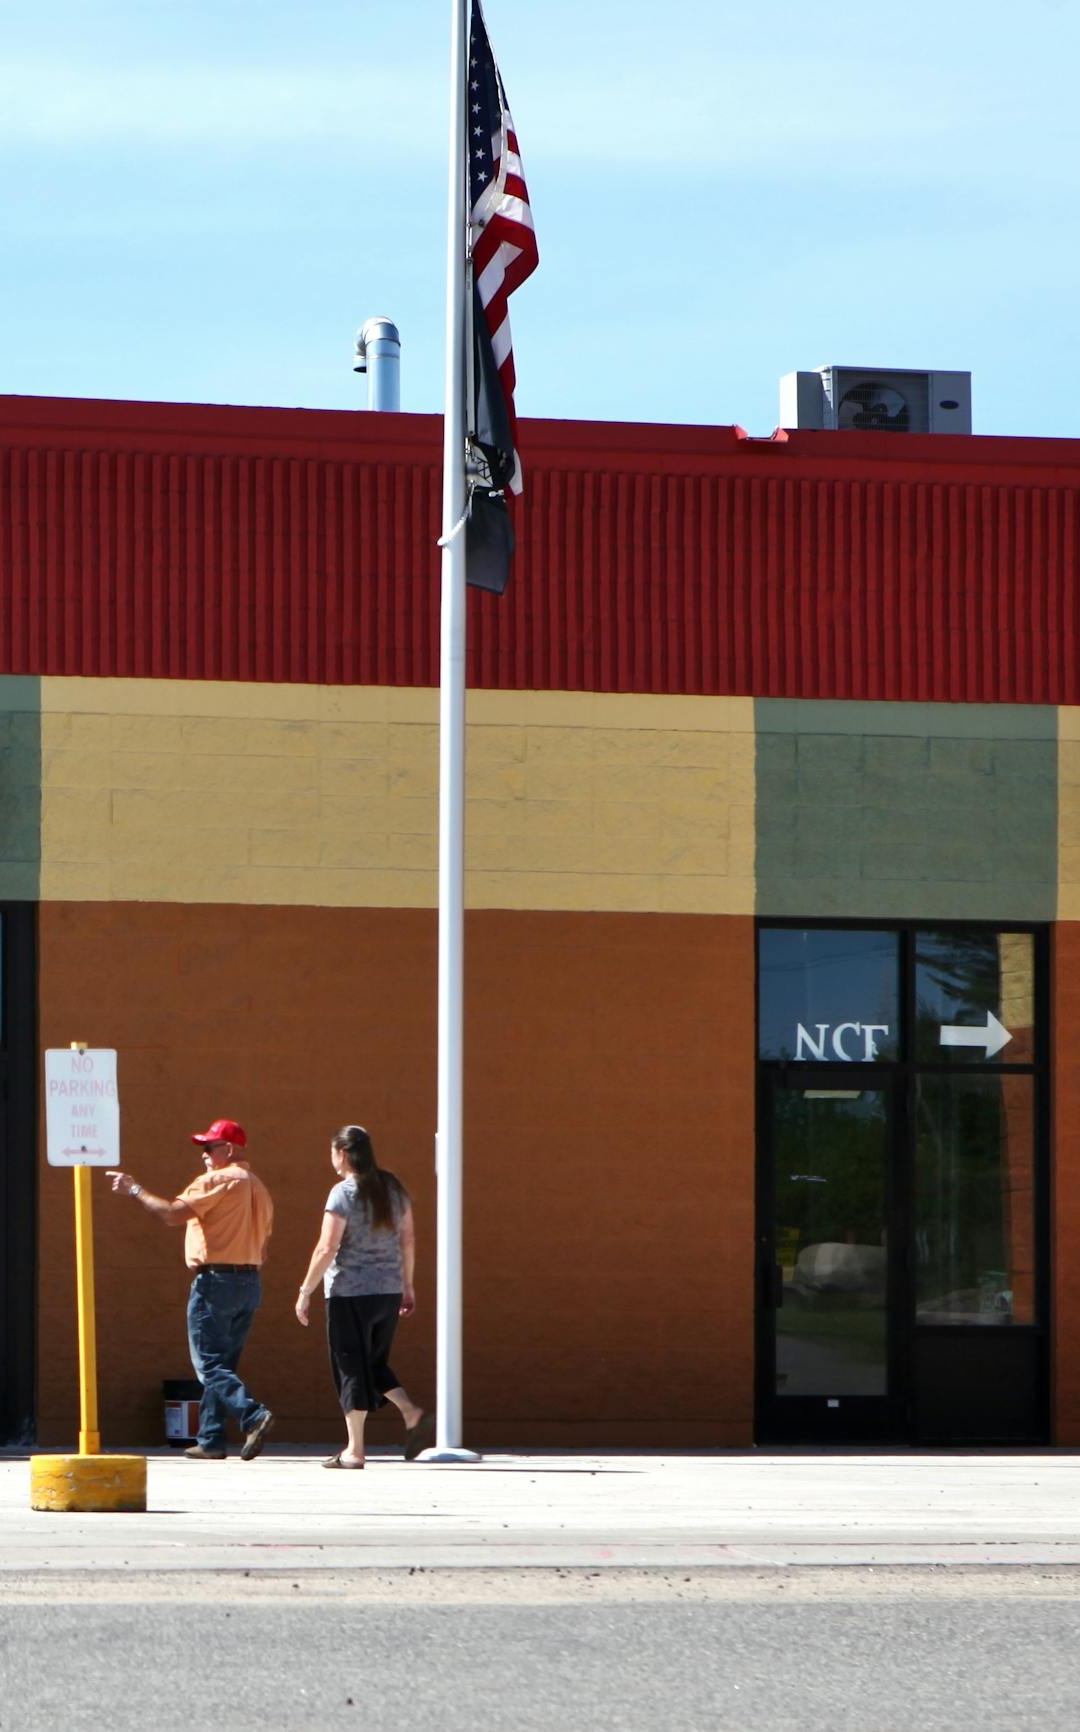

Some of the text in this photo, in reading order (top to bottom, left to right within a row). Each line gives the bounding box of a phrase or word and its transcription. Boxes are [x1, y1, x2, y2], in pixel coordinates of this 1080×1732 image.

[71, 1057, 94, 1072] NO
[50, 1080, 115, 1096] PARKING
[71, 1104, 96, 1117] ANY
[71, 1124, 97, 1138] TIME
